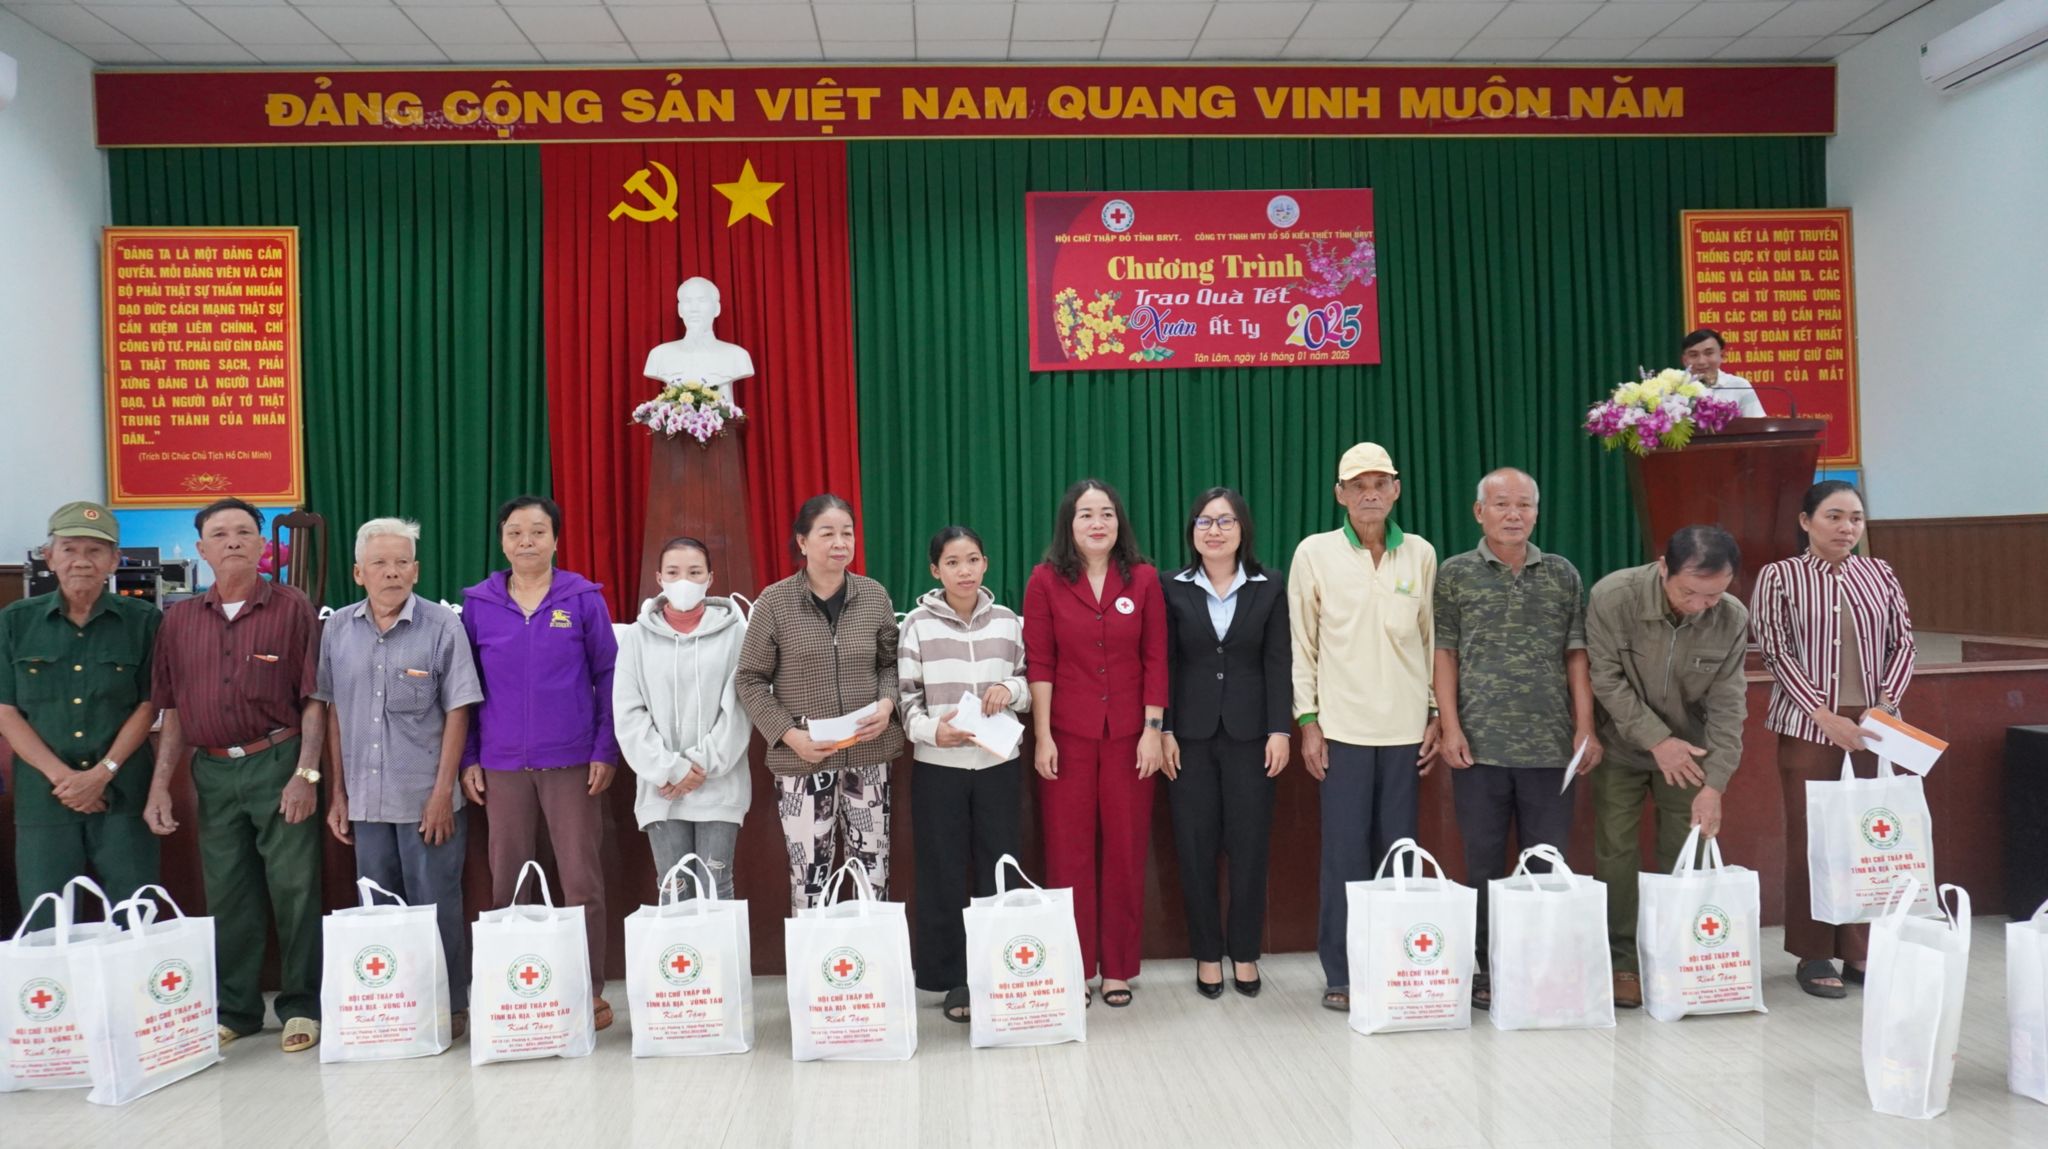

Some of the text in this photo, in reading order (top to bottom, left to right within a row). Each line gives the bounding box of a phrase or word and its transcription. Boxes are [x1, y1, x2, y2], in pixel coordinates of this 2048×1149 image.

[266, 73, 1684, 138] ĐẢNG CỘNG SẢN VIỆT NAM QUANG VINH MUÔN NĂM
[158, 248, 171, 260] TA
[175, 246, 190, 260] LÀ
[193, 246, 218, 262] MỘT
[222, 245, 252, 260] ĐẢNG
[182, 263, 282, 278] ĐẢNG VIÊN VÀ CÁN
[1108, 253, 1304, 285] Chương Trình
[117, 281, 242, 298] BỘ PHẢI THẬT SỰ THẤM
[1135, 287, 1292, 306] Trao Quà Tết
[118, 301, 284, 317] ĐẠO ĐỨC CÁCH MẠNG THẬT SỰ
[149, 319, 283, 335] KIỆM LIÊM CHÍNH, CHÍ
[1130, 306, 1198, 343] Xuân
[1209, 314, 1237, 335] Ất
[1285, 301, 1363, 350] 2025
[118, 336, 283, 352] CÔNG VÔ TƯ. PHẢI GIỮ GÌN ĐẢNG
[119, 355, 284, 372] TA THẬT TRONG SẠCH, PHẢI
[1194, 350, 1350, 363] Tân Lâm, ngày 16 tháng 01 năm 2025
[157, 374, 284, 389] ĐÁNG LÀ NGƯỜI LÃNH
[120, 392, 285, 409] ĐẠO, LÀ NGƯỜI TỚ THẬT
[120, 410, 285, 426] TRUNG THÀNH CỦA NHÂN
